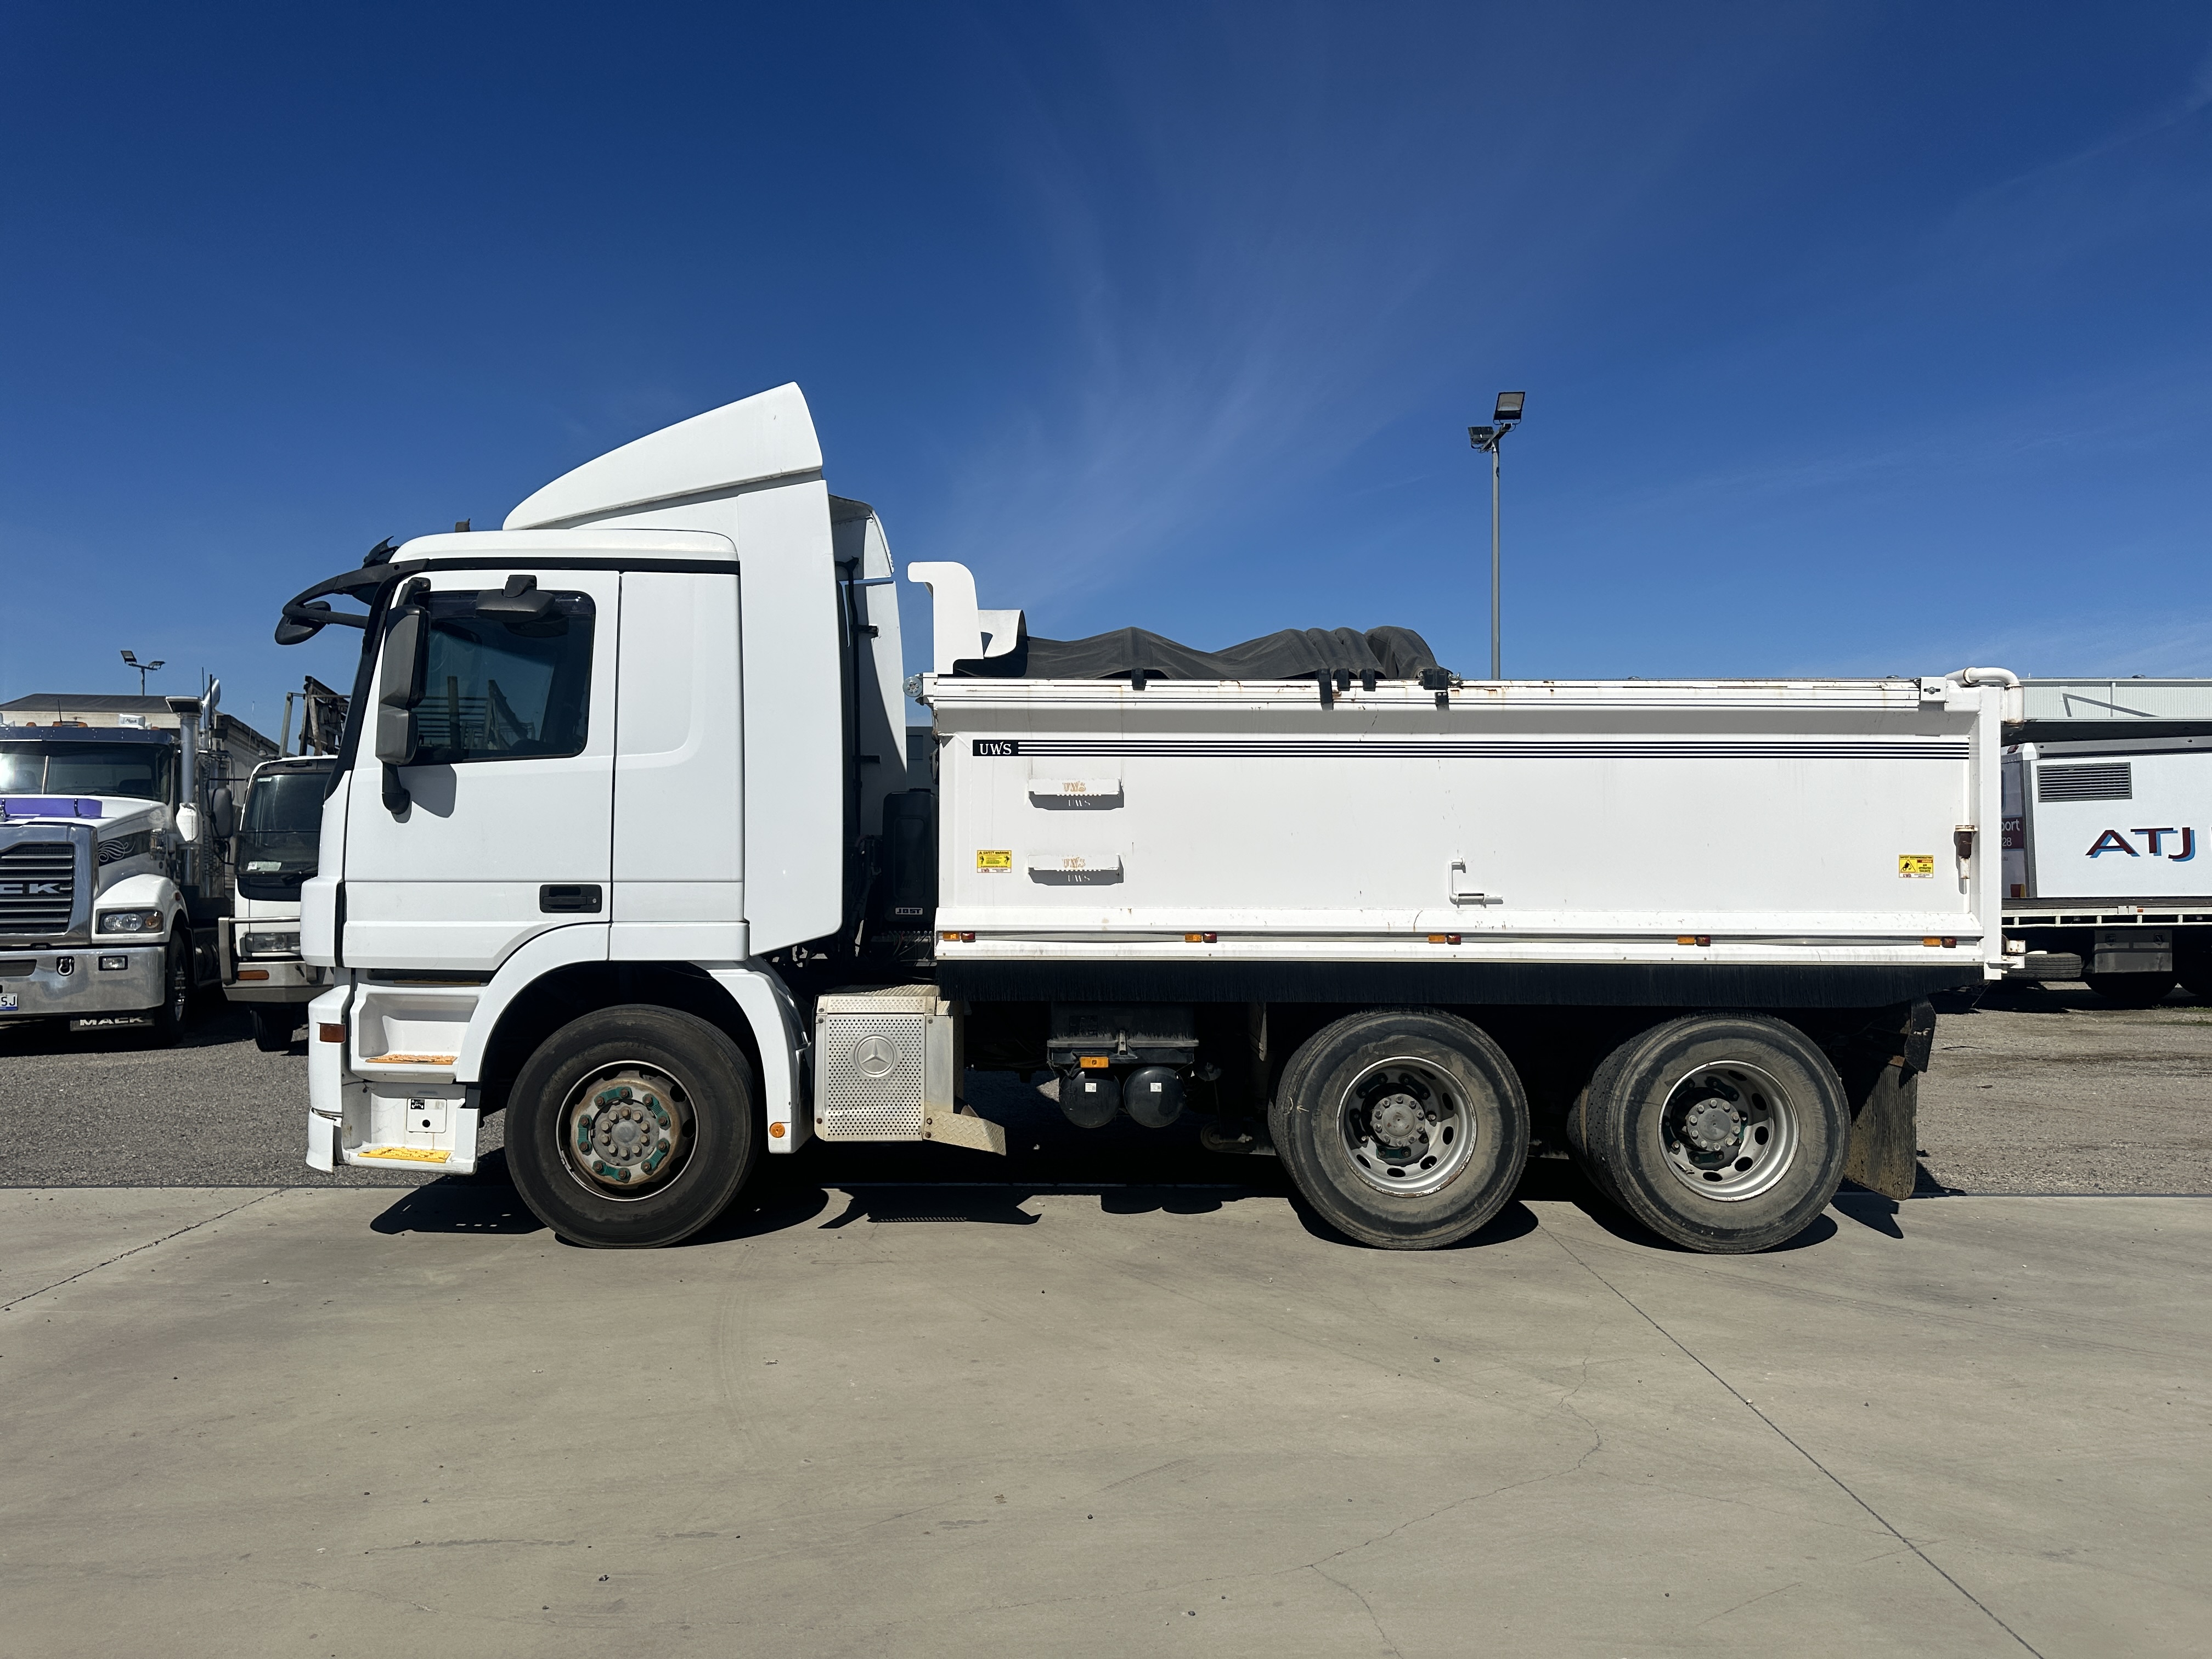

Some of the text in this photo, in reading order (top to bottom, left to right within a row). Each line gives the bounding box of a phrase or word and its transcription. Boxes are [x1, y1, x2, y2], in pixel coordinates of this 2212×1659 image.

[979, 741, 1012, 755] UWS
[1063, 781, 1086, 792] UWS
[2085, 827, 2196, 862] ATJ
[1063, 857, 1086, 868] UWS
[80, 1017, 144, 1026] MACK
